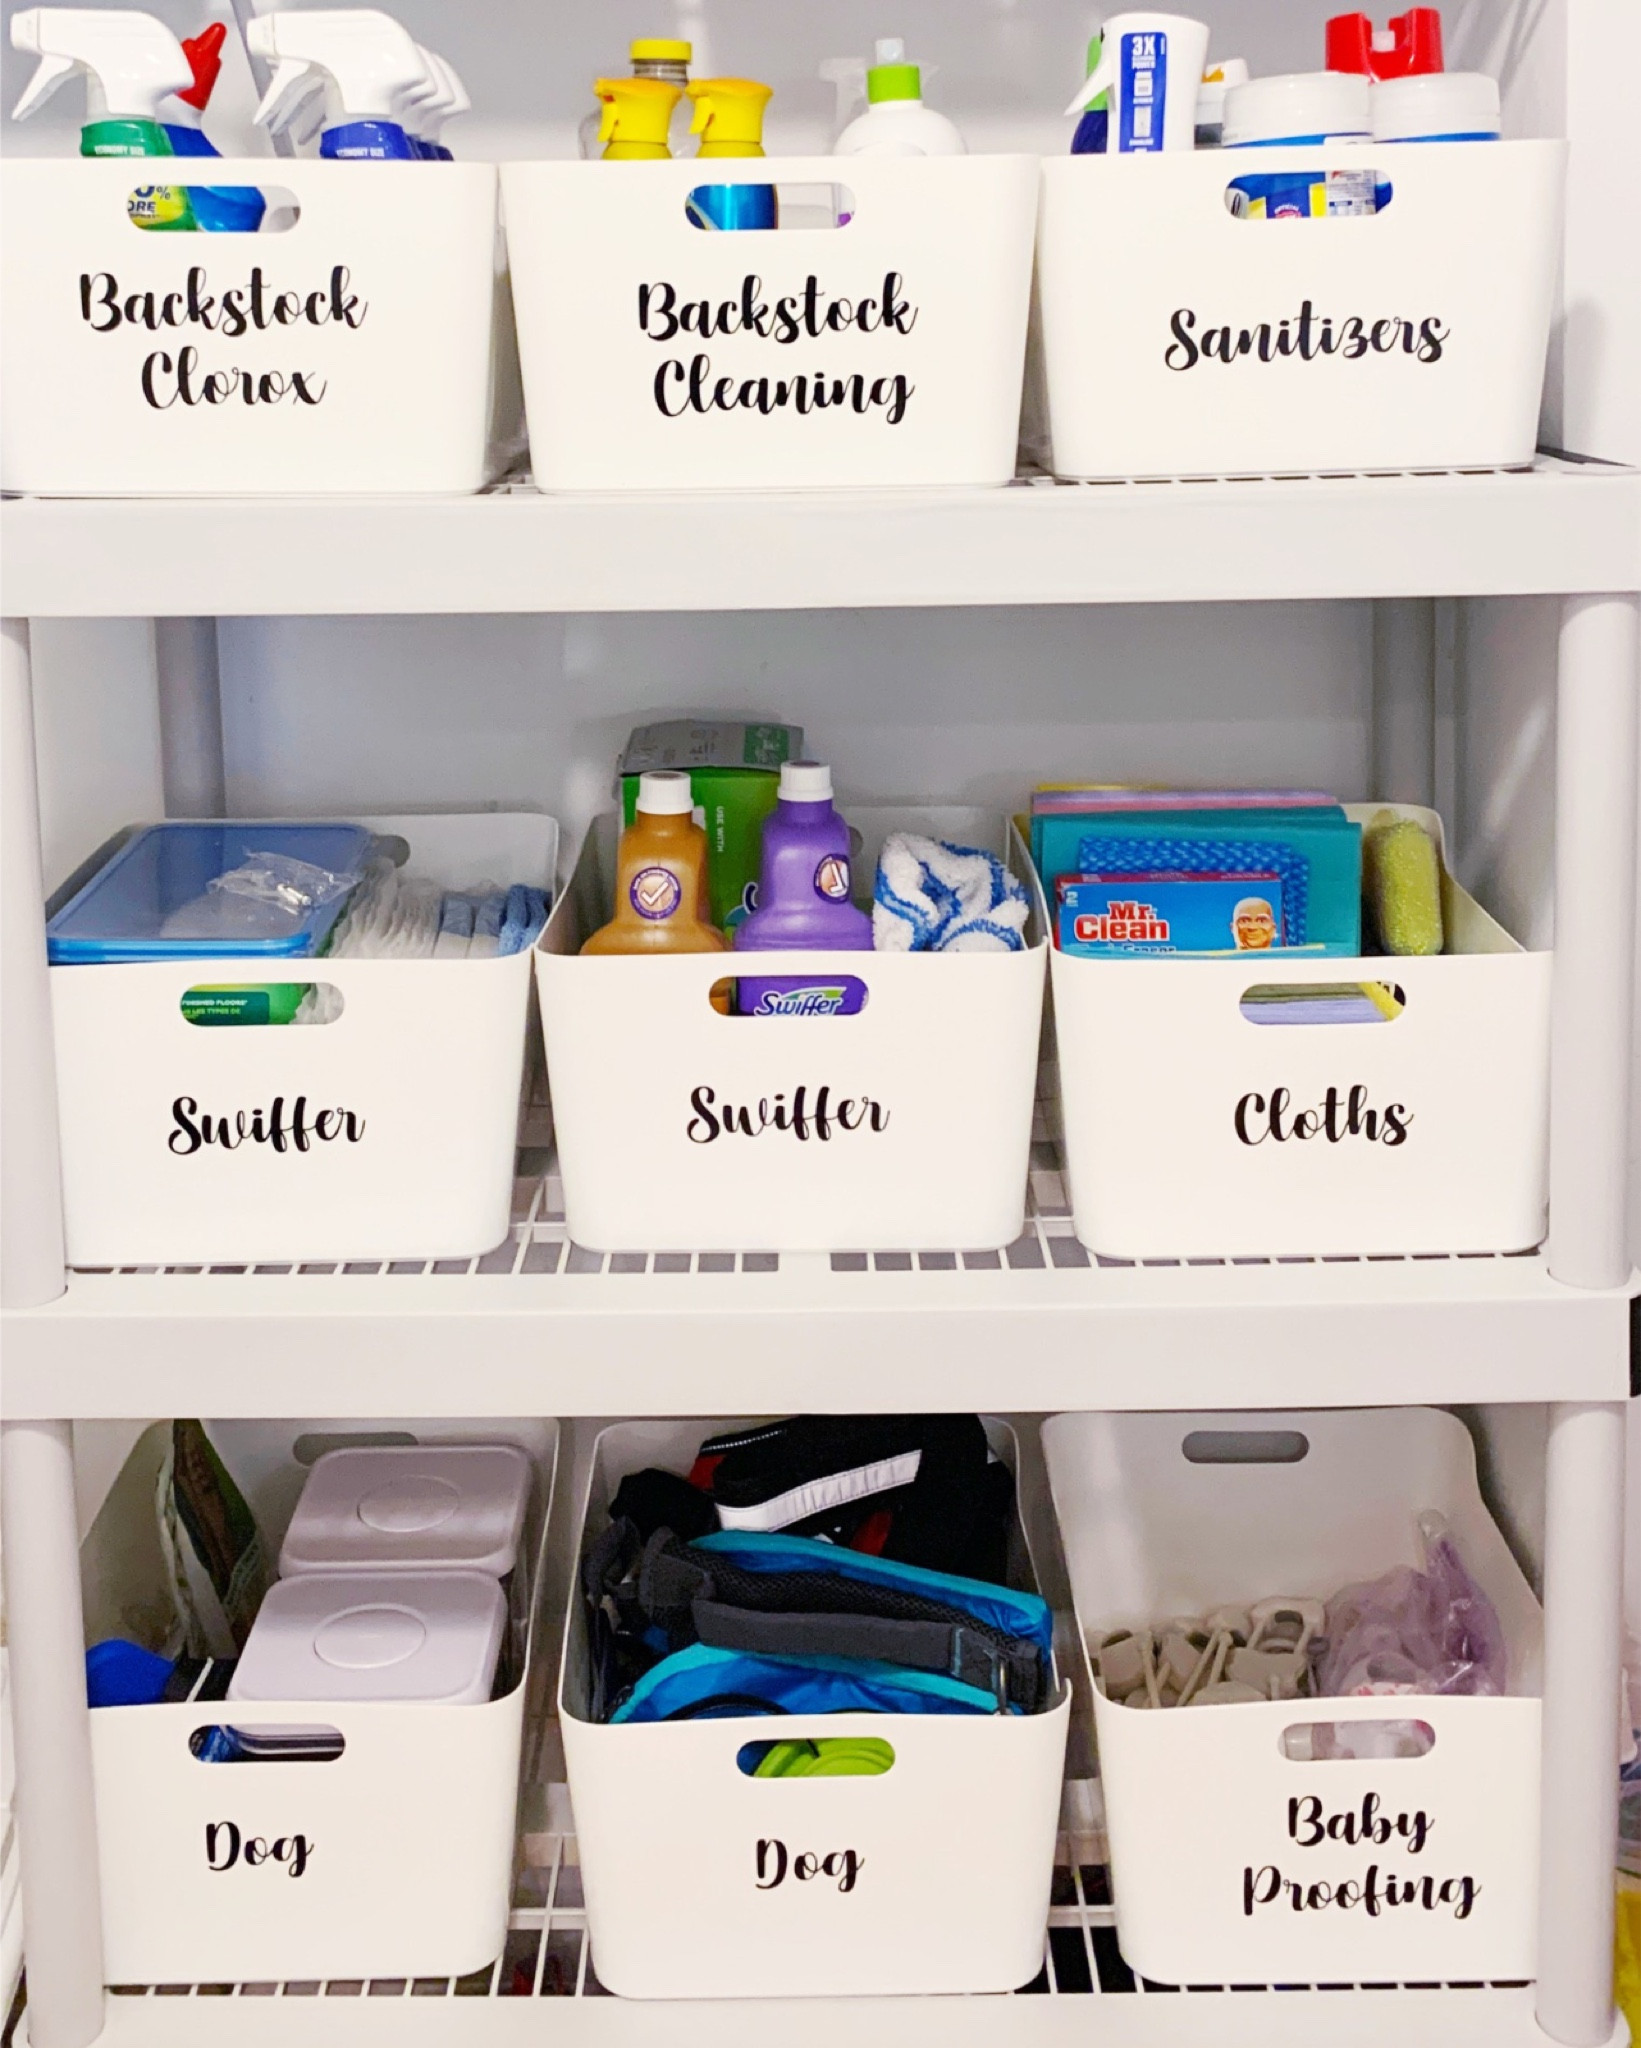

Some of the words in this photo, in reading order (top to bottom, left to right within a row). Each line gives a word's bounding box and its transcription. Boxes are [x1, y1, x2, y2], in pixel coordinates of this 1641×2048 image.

[1132, 36, 1155, 55] 3X
[127, 201, 156, 212] ORE
[80, 266, 367, 337] Backstock
[639, 272, 918, 343] Backstock
[1165, 301, 1451, 371] Sanitizers
[142, 346, 327, 409] Clorox
[654, 354, 915, 424] Cleaning
[716, 805, 724, 824] USE
[716, 827, 724, 852] WITH
[1066, 891, 1079, 905] 2
[1107, 900, 1156, 920] Mr.
[1075, 915, 1169, 941] Clean
[754, 992, 843, 1015] Swiffer
[168, 1096, 366, 1155] Swiffer
[687, 1086, 889, 1144] Swiffer
[1235, 1085, 1414, 1146] Cloths
[206, 1822, 315, 1877] Dog
[1289, 1792, 1435, 1853] Baby
[756, 1839, 865, 1892] Dog
[1244, 1865, 1482, 1919] Proofing
